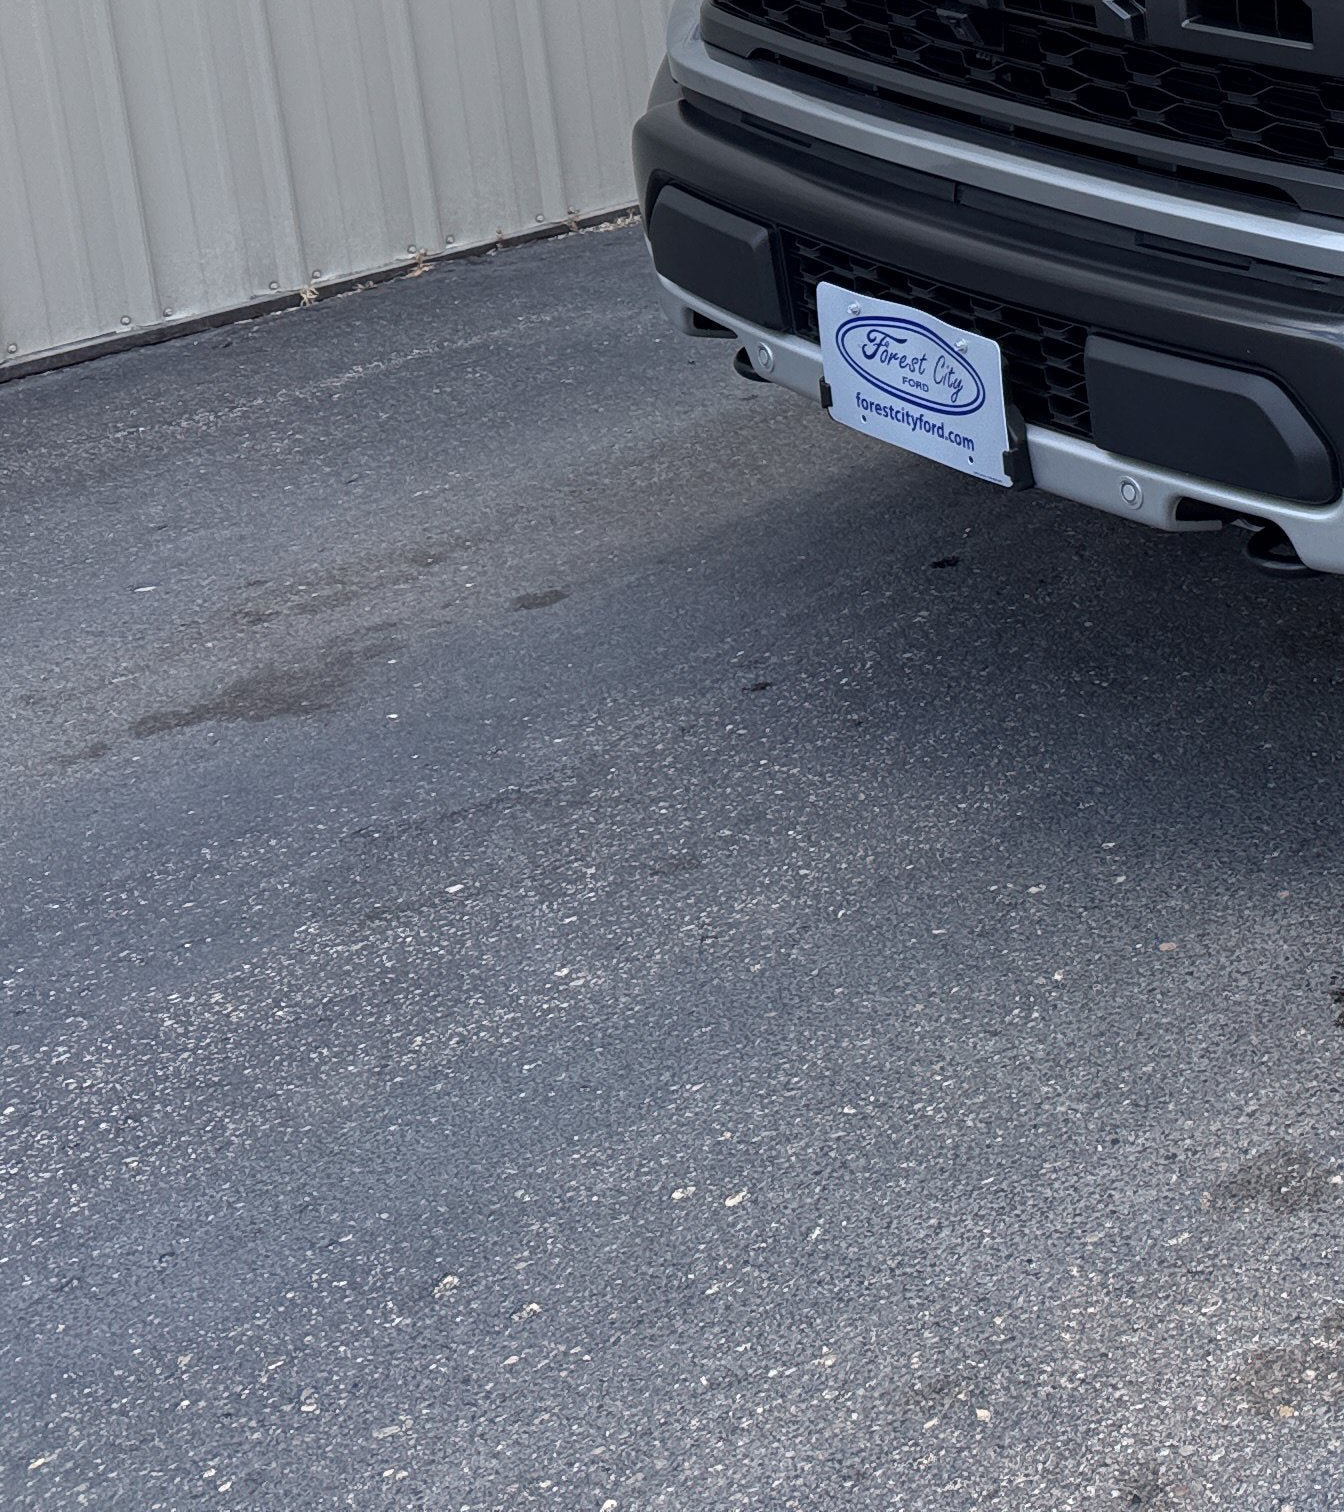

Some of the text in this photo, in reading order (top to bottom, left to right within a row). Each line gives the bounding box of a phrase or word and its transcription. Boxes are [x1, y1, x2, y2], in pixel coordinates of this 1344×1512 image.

[861, 329, 964, 403] Forest City
[901, 376, 930, 393] FORD
[855, 391, 975, 452] forestcityford.com
